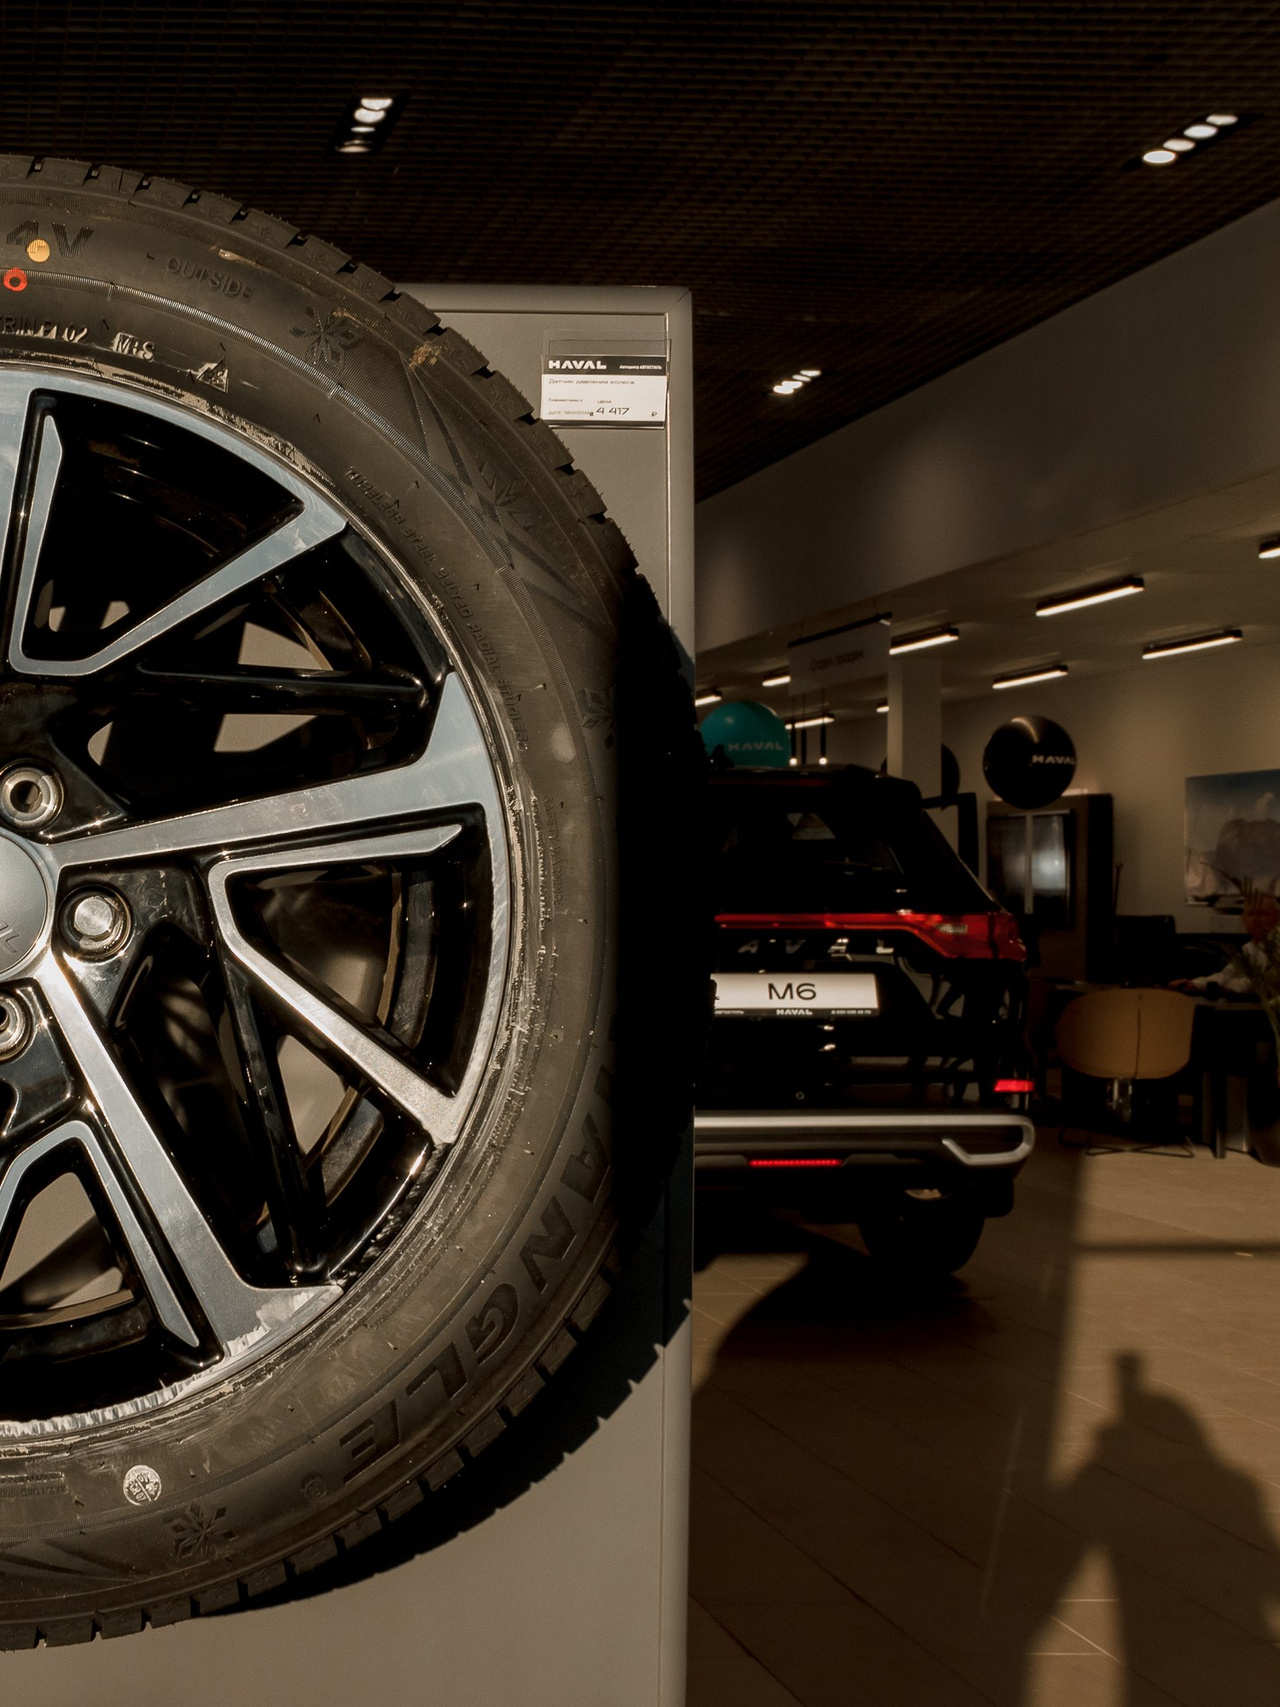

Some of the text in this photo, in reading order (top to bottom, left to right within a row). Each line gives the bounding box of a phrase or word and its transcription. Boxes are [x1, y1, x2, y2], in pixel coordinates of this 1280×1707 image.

[164, 255, 255, 303] OUTSIDE
[548, 360, 607, 370] HAVAL
[400, 523, 439, 567] STEEL
[432, 565, 475, 620] BELTED
[465, 618, 502, 674] RADIAL
[728, 741, 784, 752] HAVAL
[767, 982, 817, 1001] M6
[20, 1486, 45, 1497] LOAD
